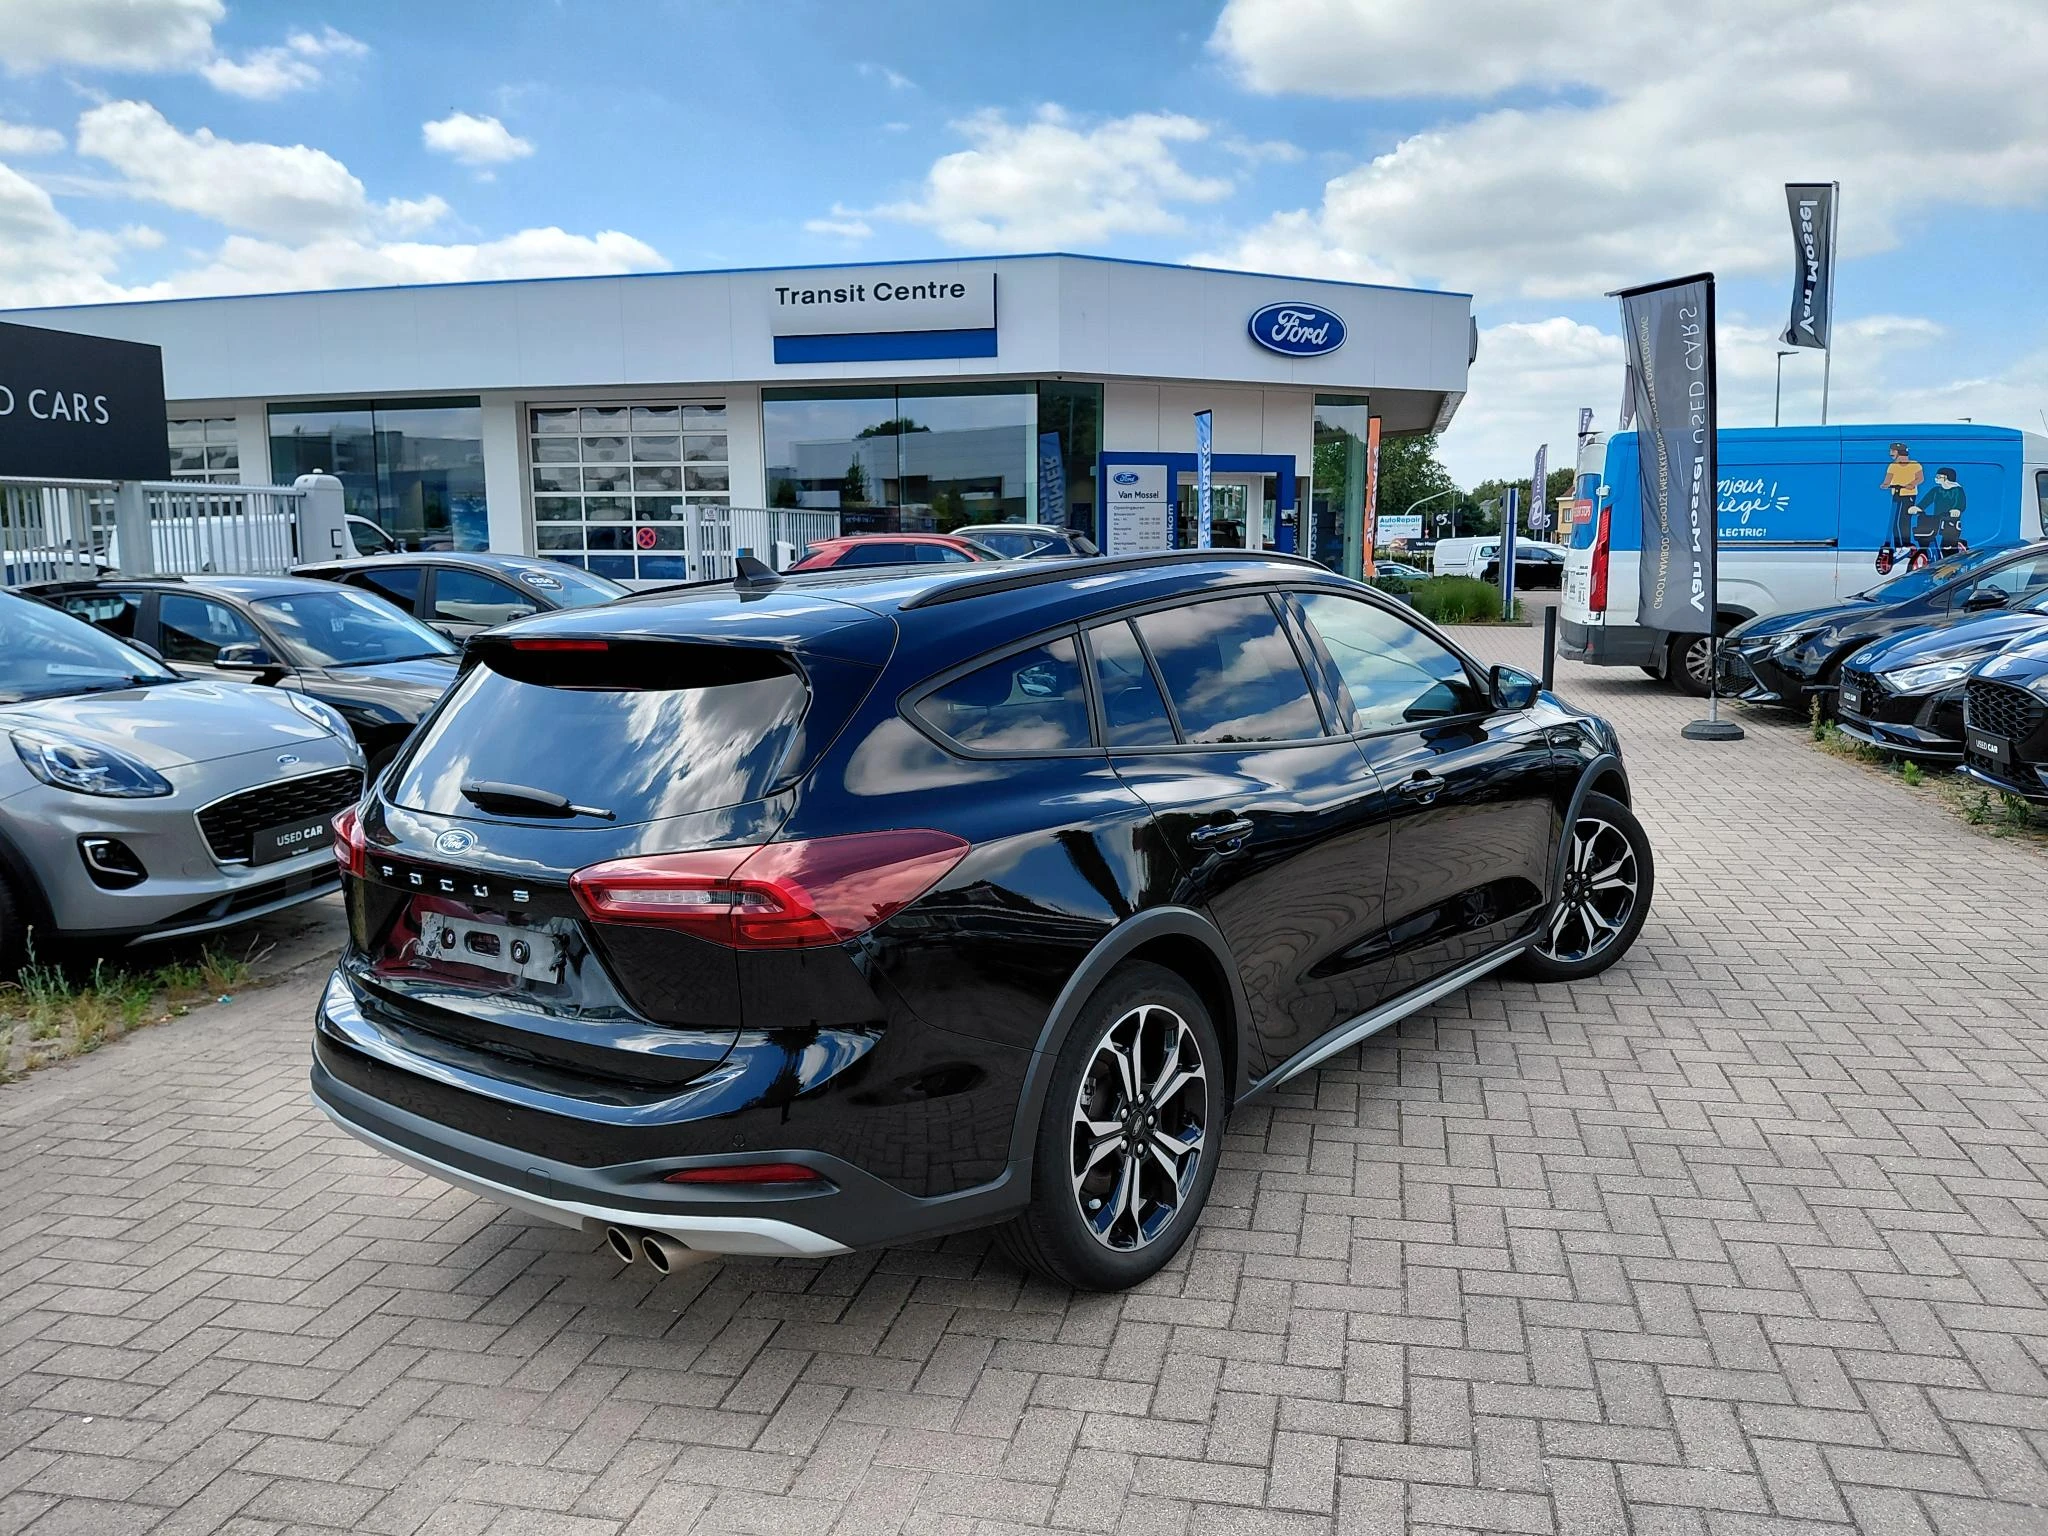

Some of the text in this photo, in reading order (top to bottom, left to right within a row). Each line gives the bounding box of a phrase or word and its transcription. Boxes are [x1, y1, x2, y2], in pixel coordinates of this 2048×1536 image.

[774, 281, 966, 306] Transit Centre
[1271, 309, 1330, 345] Ford
[28, 389, 110, 425] CARS
[1117, 490, 1160, 499] Van Mossel
[1717, 477, 1766, 497] njour,
[1380, 516, 1420, 524] AutoRepair
[1718, 528, 1767, 537] LECTRIC!
[1987, 743, 1999, 754] CAR
[276, 825, 324, 847] USED CAR
[381, 865, 531, 903] FOCUS
